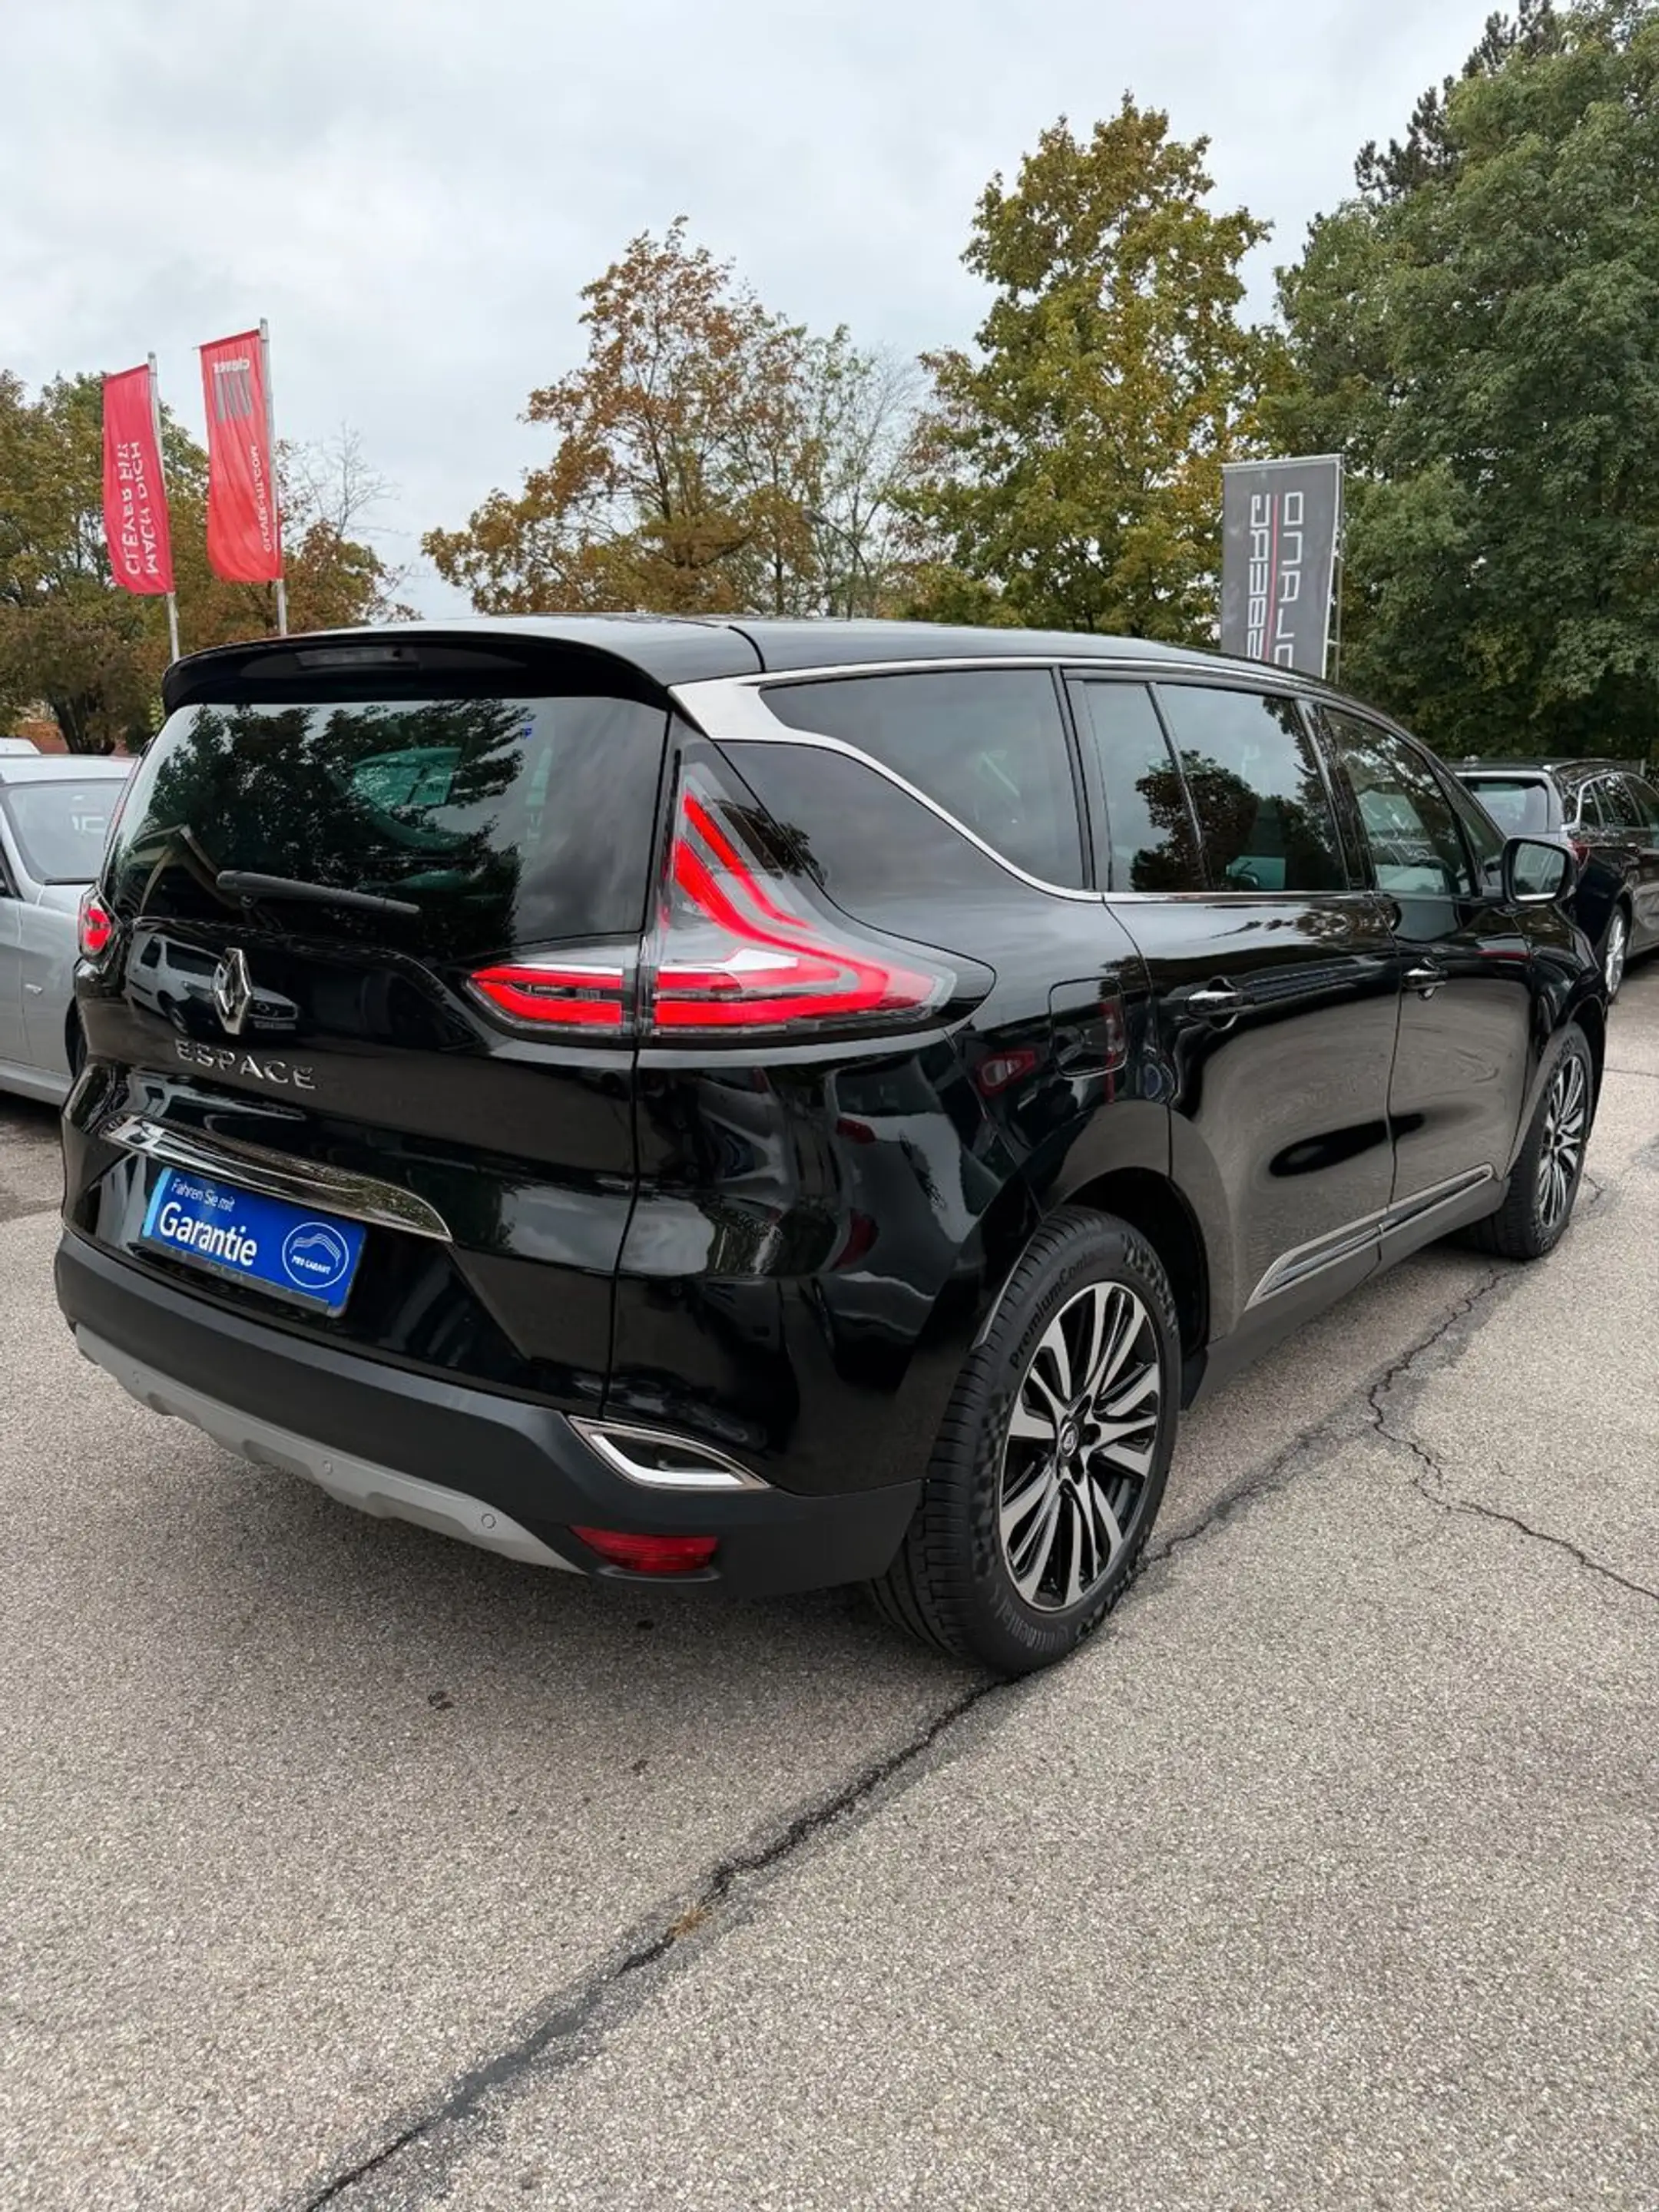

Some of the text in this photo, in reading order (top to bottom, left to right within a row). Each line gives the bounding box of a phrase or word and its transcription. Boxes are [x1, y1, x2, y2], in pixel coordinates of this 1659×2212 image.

[175, 1039, 316, 1090] ESPACE
[171, 1178, 236, 1213] Fahren Sie mit
[159, 1202, 257, 1266] Garantie
